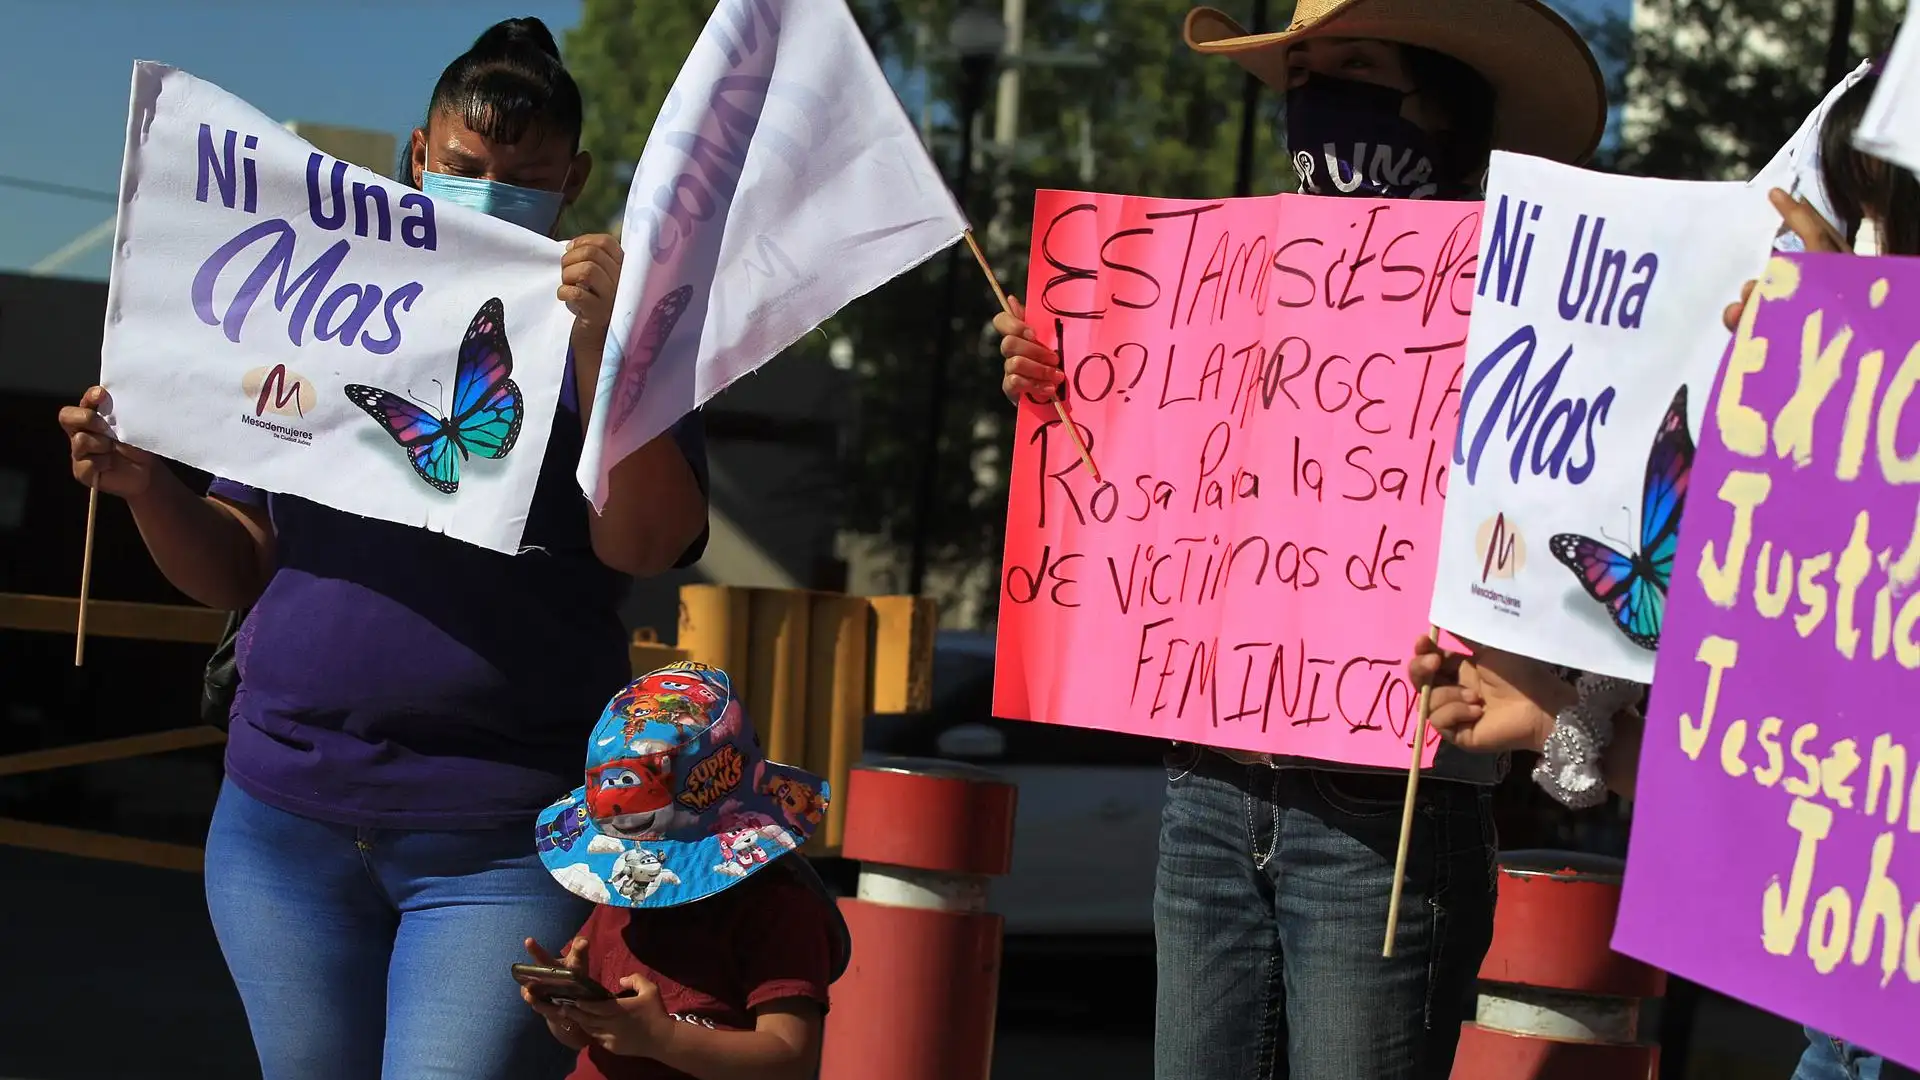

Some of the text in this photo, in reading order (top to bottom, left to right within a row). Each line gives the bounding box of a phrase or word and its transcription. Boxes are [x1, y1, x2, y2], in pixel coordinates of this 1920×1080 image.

[195, 123, 438, 251] Ni Una
[191, 218, 424, 355] Mas
[1477, 194, 1658, 329] Ni Una
[241, 414, 313, 440] Mesademujeres
[1452, 324, 1616, 485] Mas
[1030, 419, 1177, 528] Rosa
[1193, 421, 1260, 514] Para
[1293, 435, 1323, 502] la
[680, 755, 742, 809] WINGS
